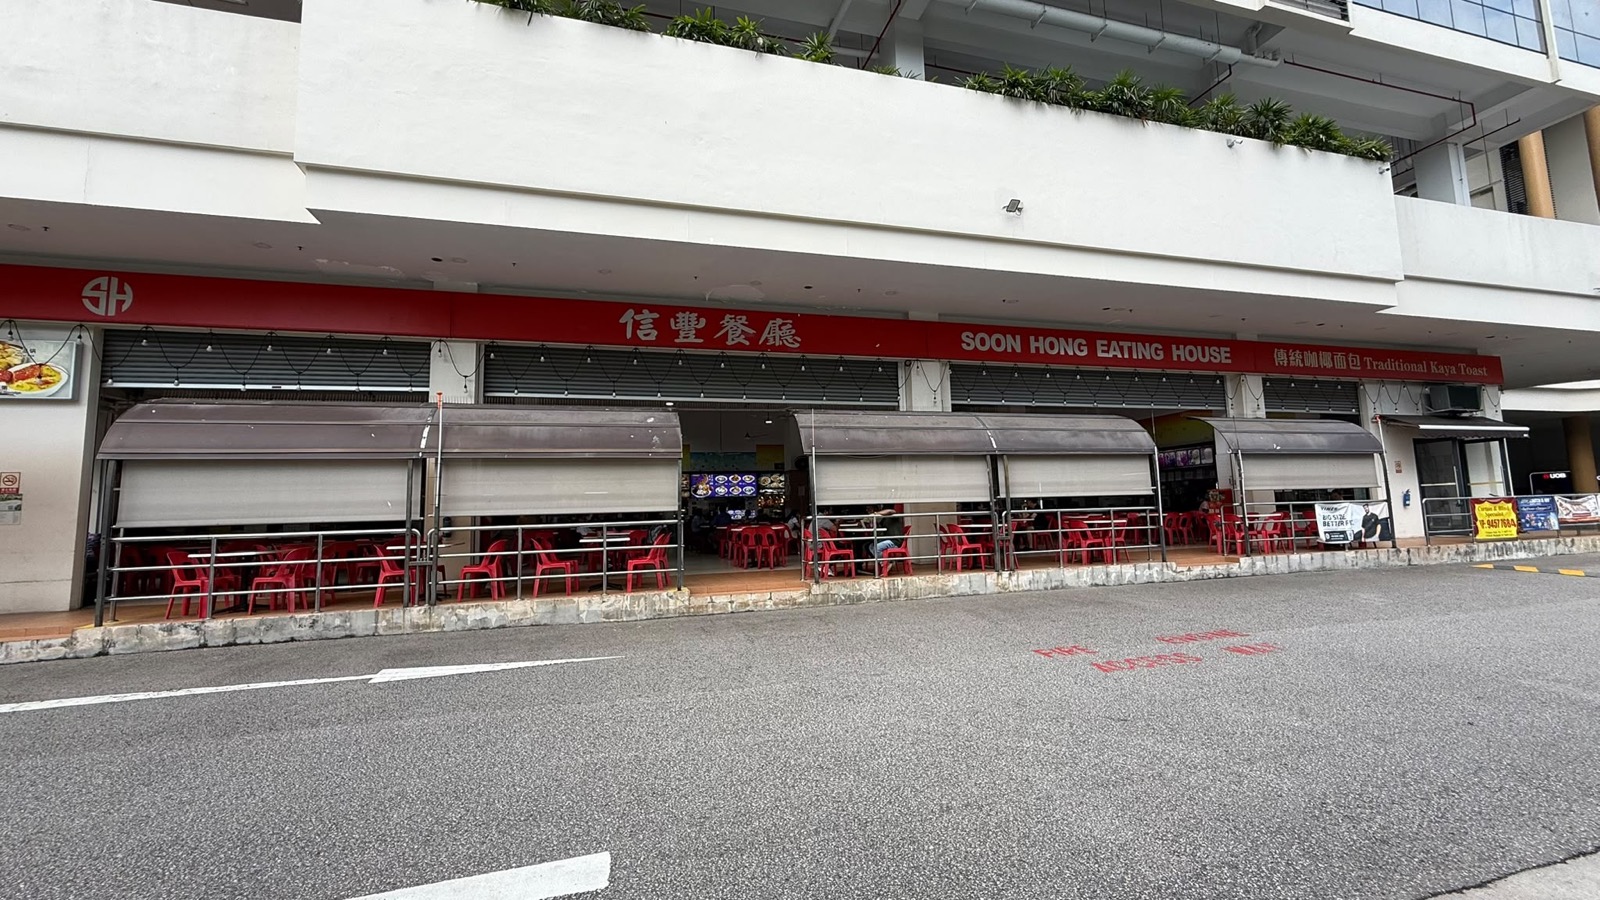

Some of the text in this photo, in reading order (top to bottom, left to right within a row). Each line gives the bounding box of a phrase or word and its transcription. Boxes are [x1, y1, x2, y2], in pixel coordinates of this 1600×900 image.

[81, 276, 134, 316] SH
[619, 308, 802, 348] 信豐餐廳
[961, 331, 1232, 364] SOON HONG EATING HOUSE
[1274, 348, 1361, 370] 傳統咖椰面包
[1363, 356, 1488, 377] Traditional Kaya Toast
